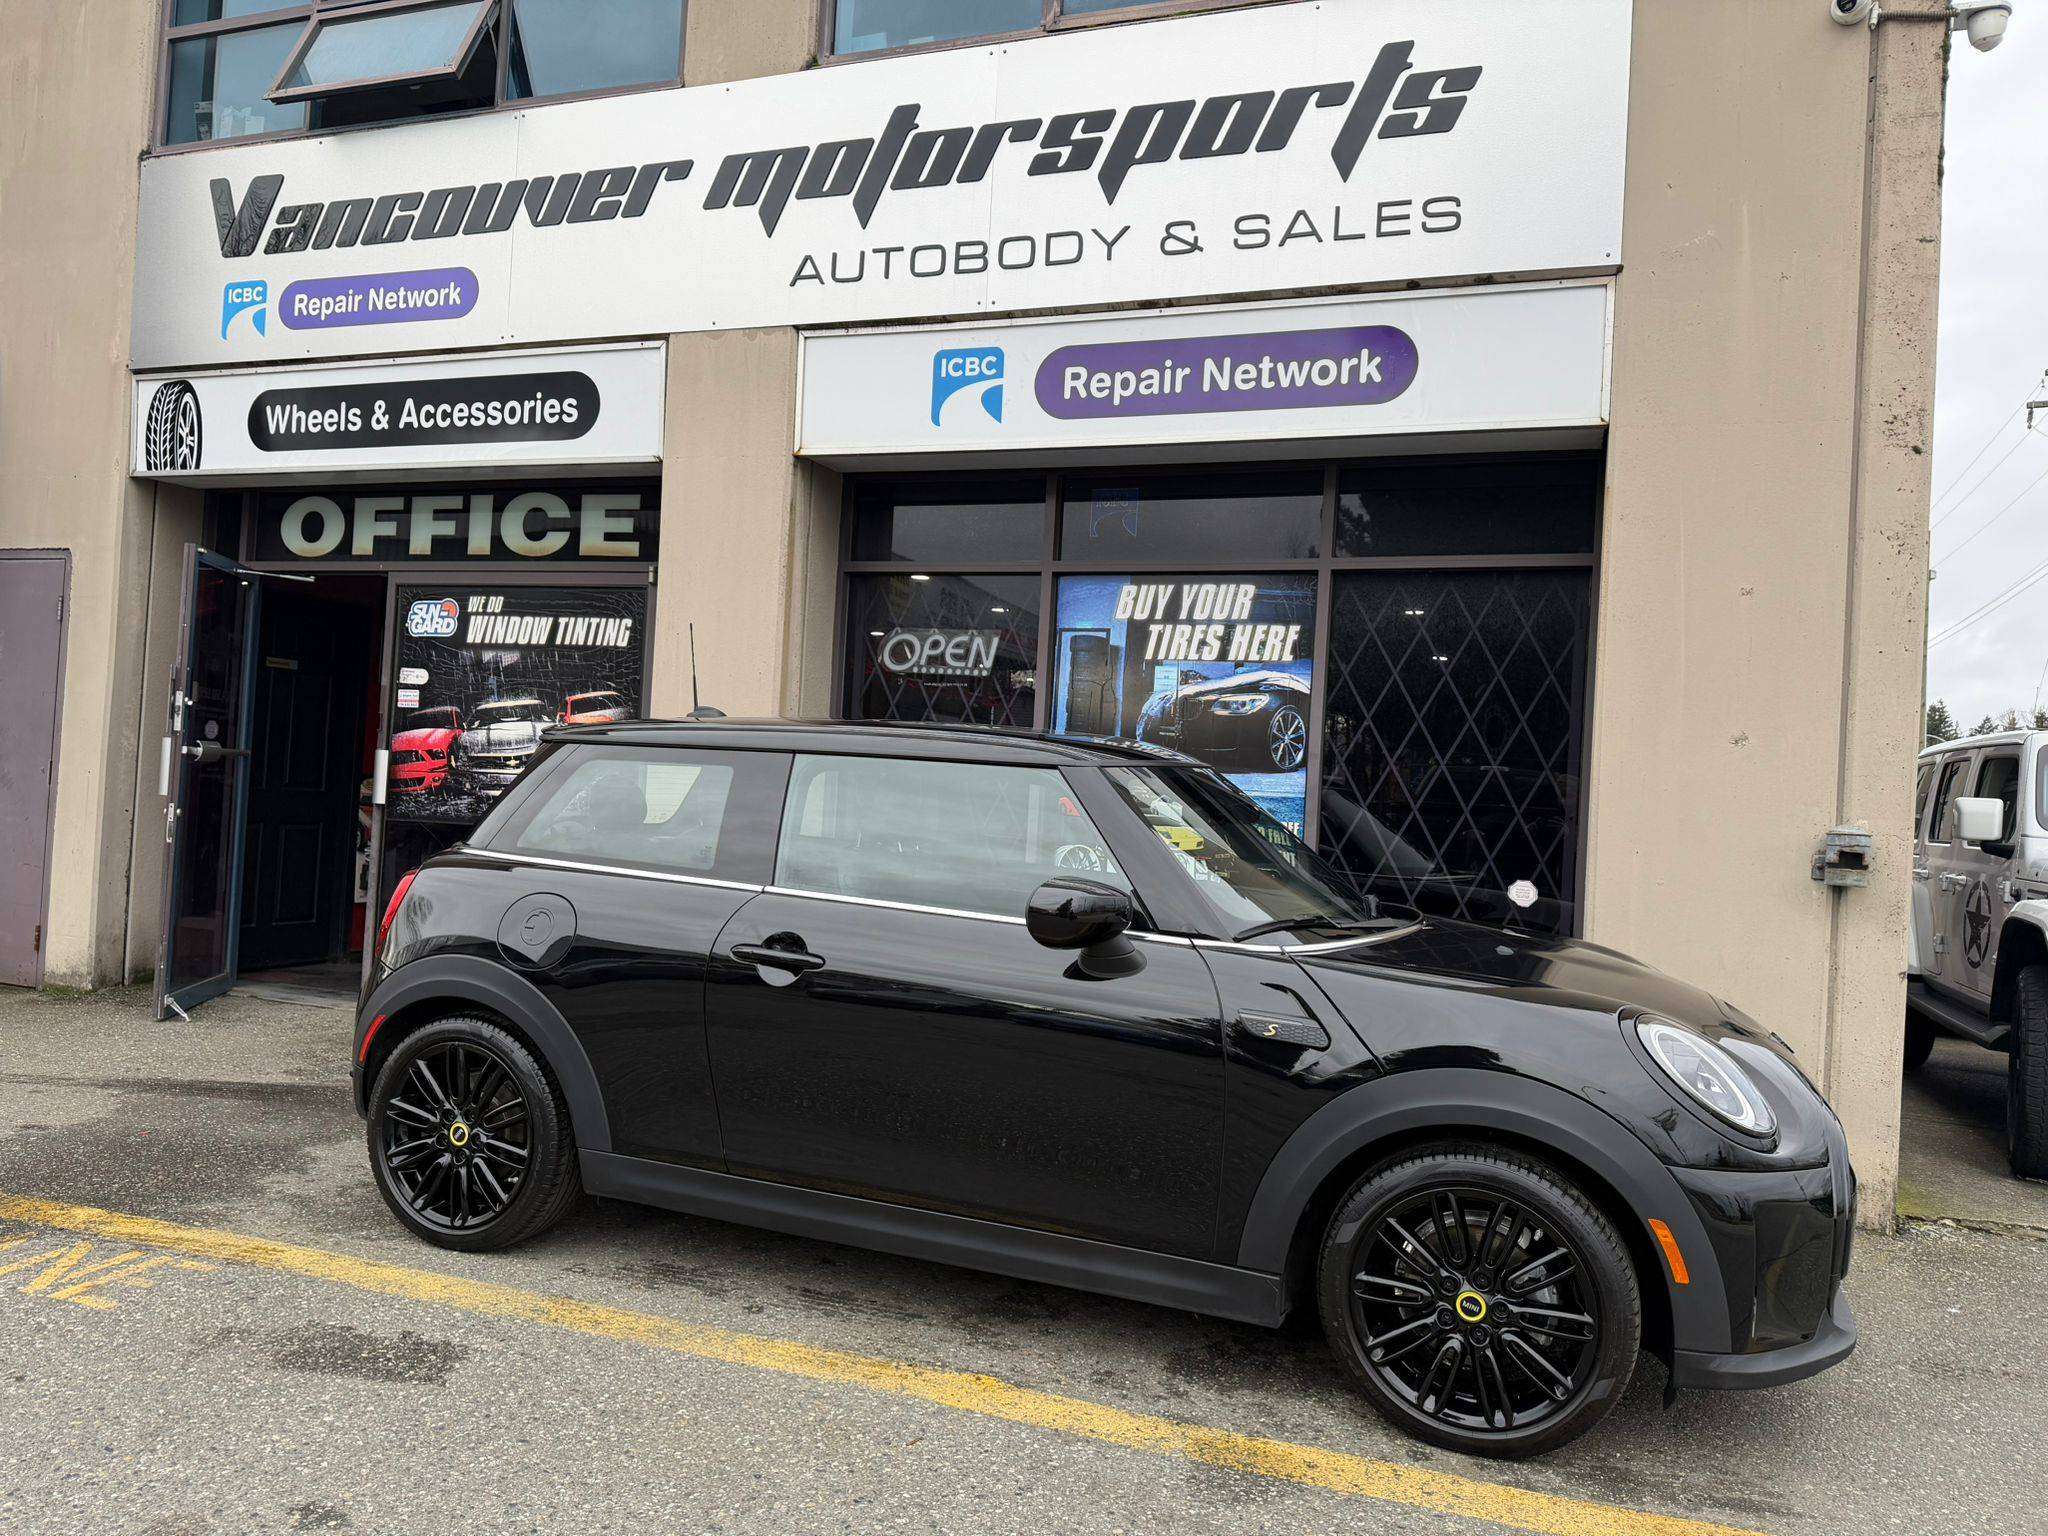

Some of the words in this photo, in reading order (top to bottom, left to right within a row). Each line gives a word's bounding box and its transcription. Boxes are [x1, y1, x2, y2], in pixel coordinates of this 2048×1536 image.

[210, 159, 694, 258] Vancouver
[703, 40, 1483, 238] motorsports
[790, 225, 1131, 288] AUTOBODY
[1160, 220, 1205, 256] &
[1233, 196, 1464, 250] SALES
[228, 286, 263, 304] ICBC
[293, 289, 363, 320] Repair
[367, 282, 462, 313] Network
[940, 355, 997, 378] ICBC
[1063, 358, 1193, 406] Repair
[1202, 348, 1383, 394] Network
[265, 397, 361, 437] Wheels
[371, 400, 390, 432] &
[398, 391, 579, 430] Accessories
[280, 492, 642, 557] OFFICE
[467, 596, 487, 613] WE
[487, 596, 504, 613] DO
[1115, 585, 1174, 620] BUY
[1179, 584, 1256, 620] YOUR
[410, 619, 456, 635] GARD
[467, 615, 553, 644] WINDOW
[555, 616, 632, 647] TINTING
[1144, 624, 1225, 661] TIRES
[1228, 625, 1301, 661] HERE
[883, 633, 1000, 671] OPEN
[1263, 1023, 1279, 1036] S
